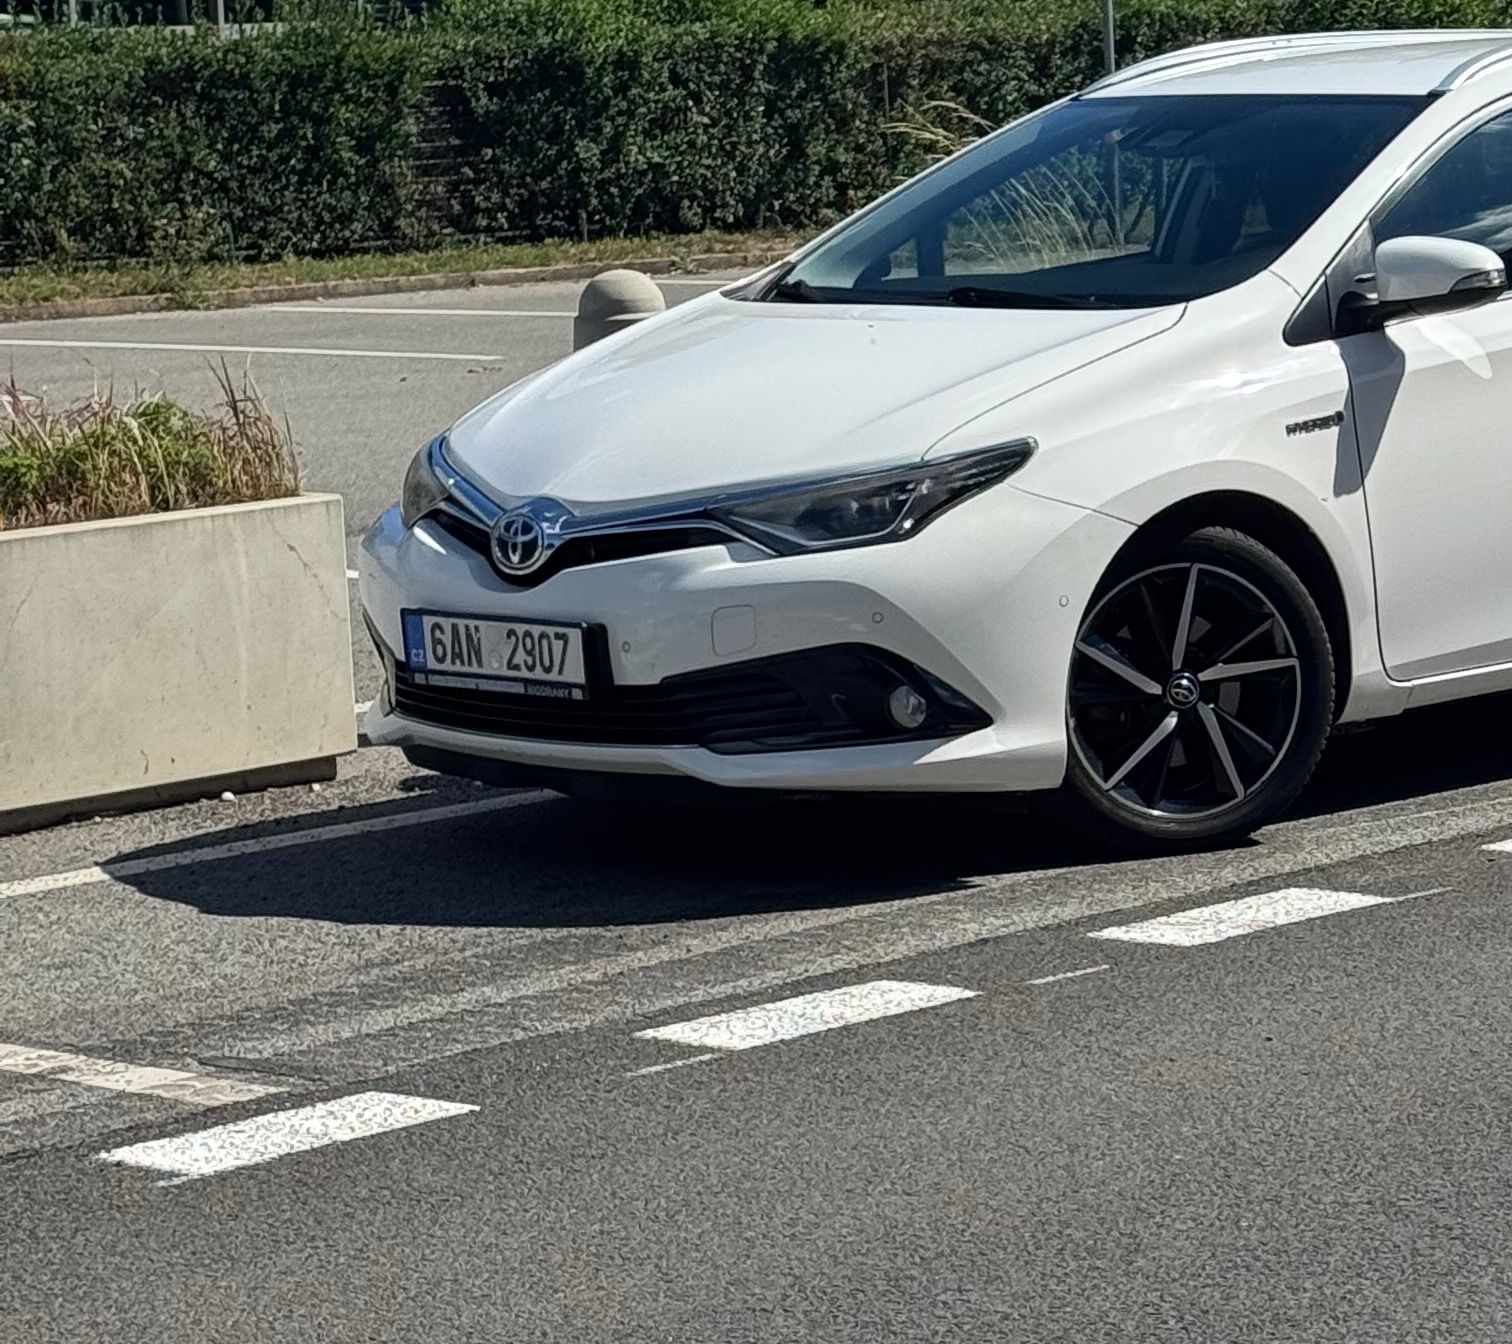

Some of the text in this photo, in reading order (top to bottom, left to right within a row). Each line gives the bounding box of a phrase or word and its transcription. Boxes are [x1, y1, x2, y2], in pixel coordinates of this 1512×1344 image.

[412, 649, 424, 662] CZ
[430, 621, 569, 676] 6AN 2907
